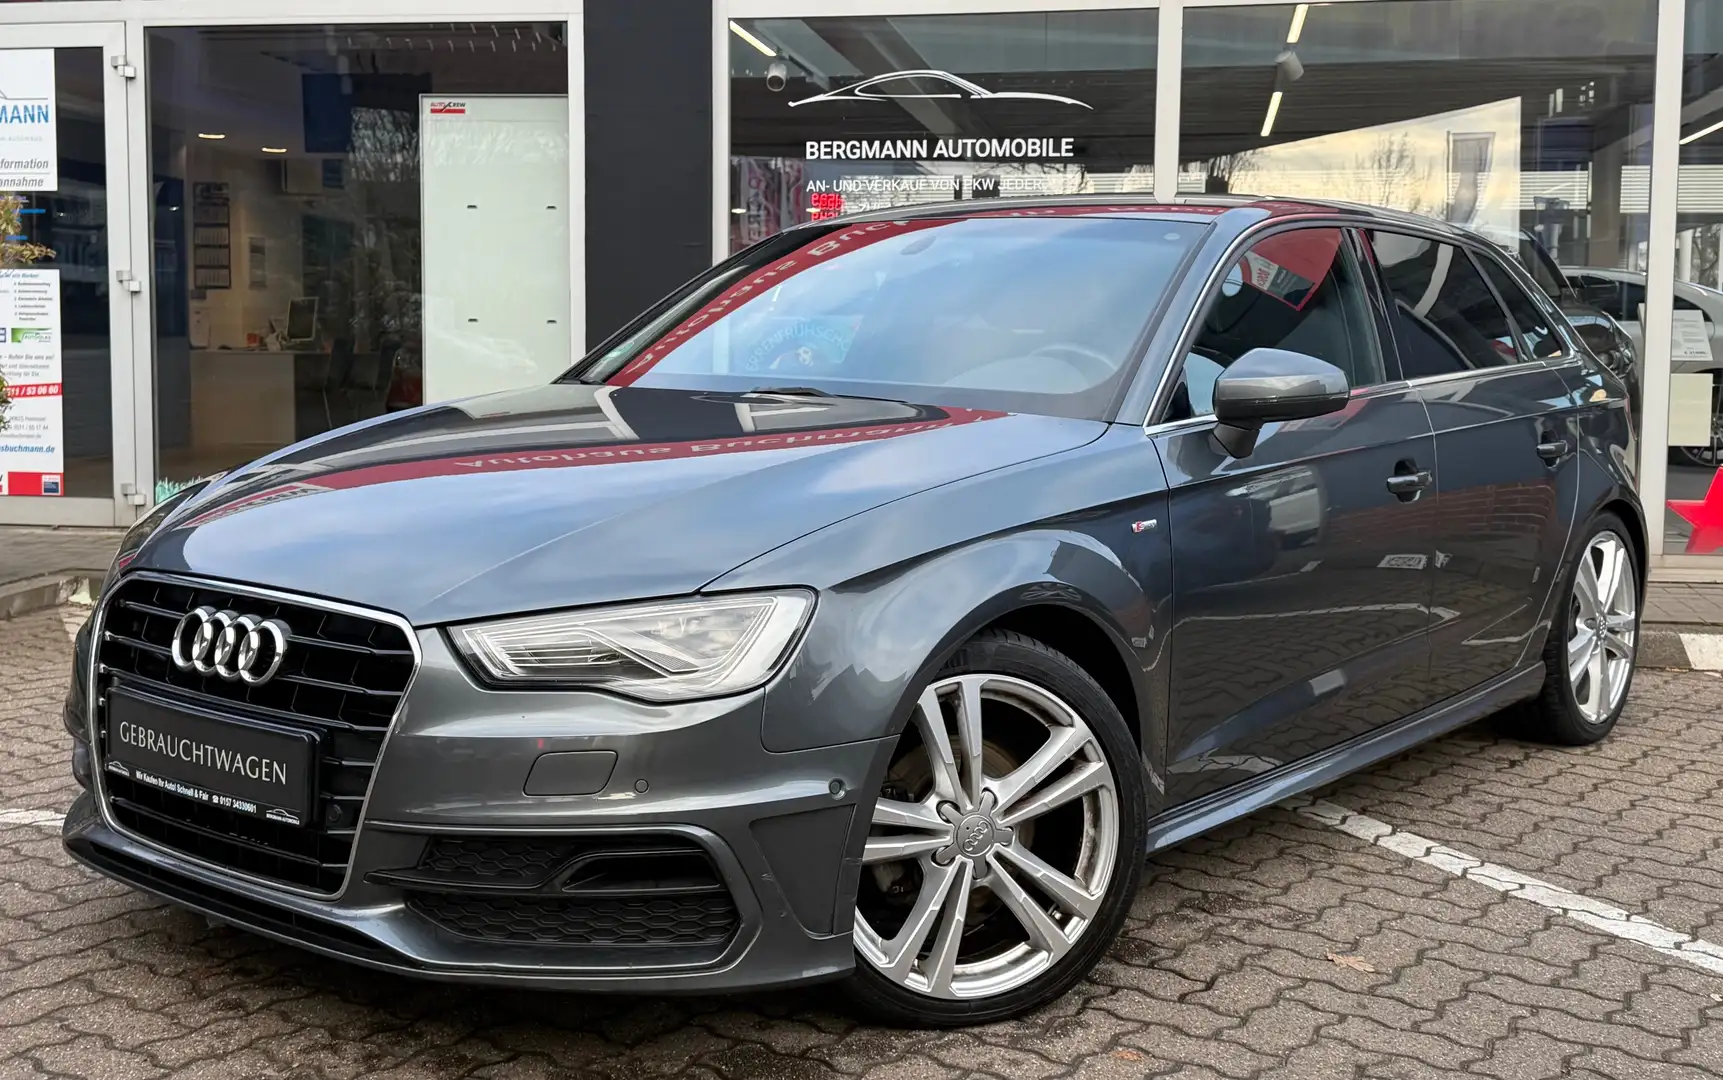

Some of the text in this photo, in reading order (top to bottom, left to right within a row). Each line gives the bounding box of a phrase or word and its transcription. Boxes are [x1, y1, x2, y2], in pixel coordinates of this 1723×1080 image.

[805, 138, 1075, 160] BERGMANN AUTOMOBILE
[806, 179, 830, 192] AN-
[833, 179, 862, 192] UND
[867, 178, 928, 192] VERKAUF
[931, 178, 960, 191] VON
[963, 178, 995, 191] PKW
[119, 721, 287, 786] GEBRAUCHTWAGEN
